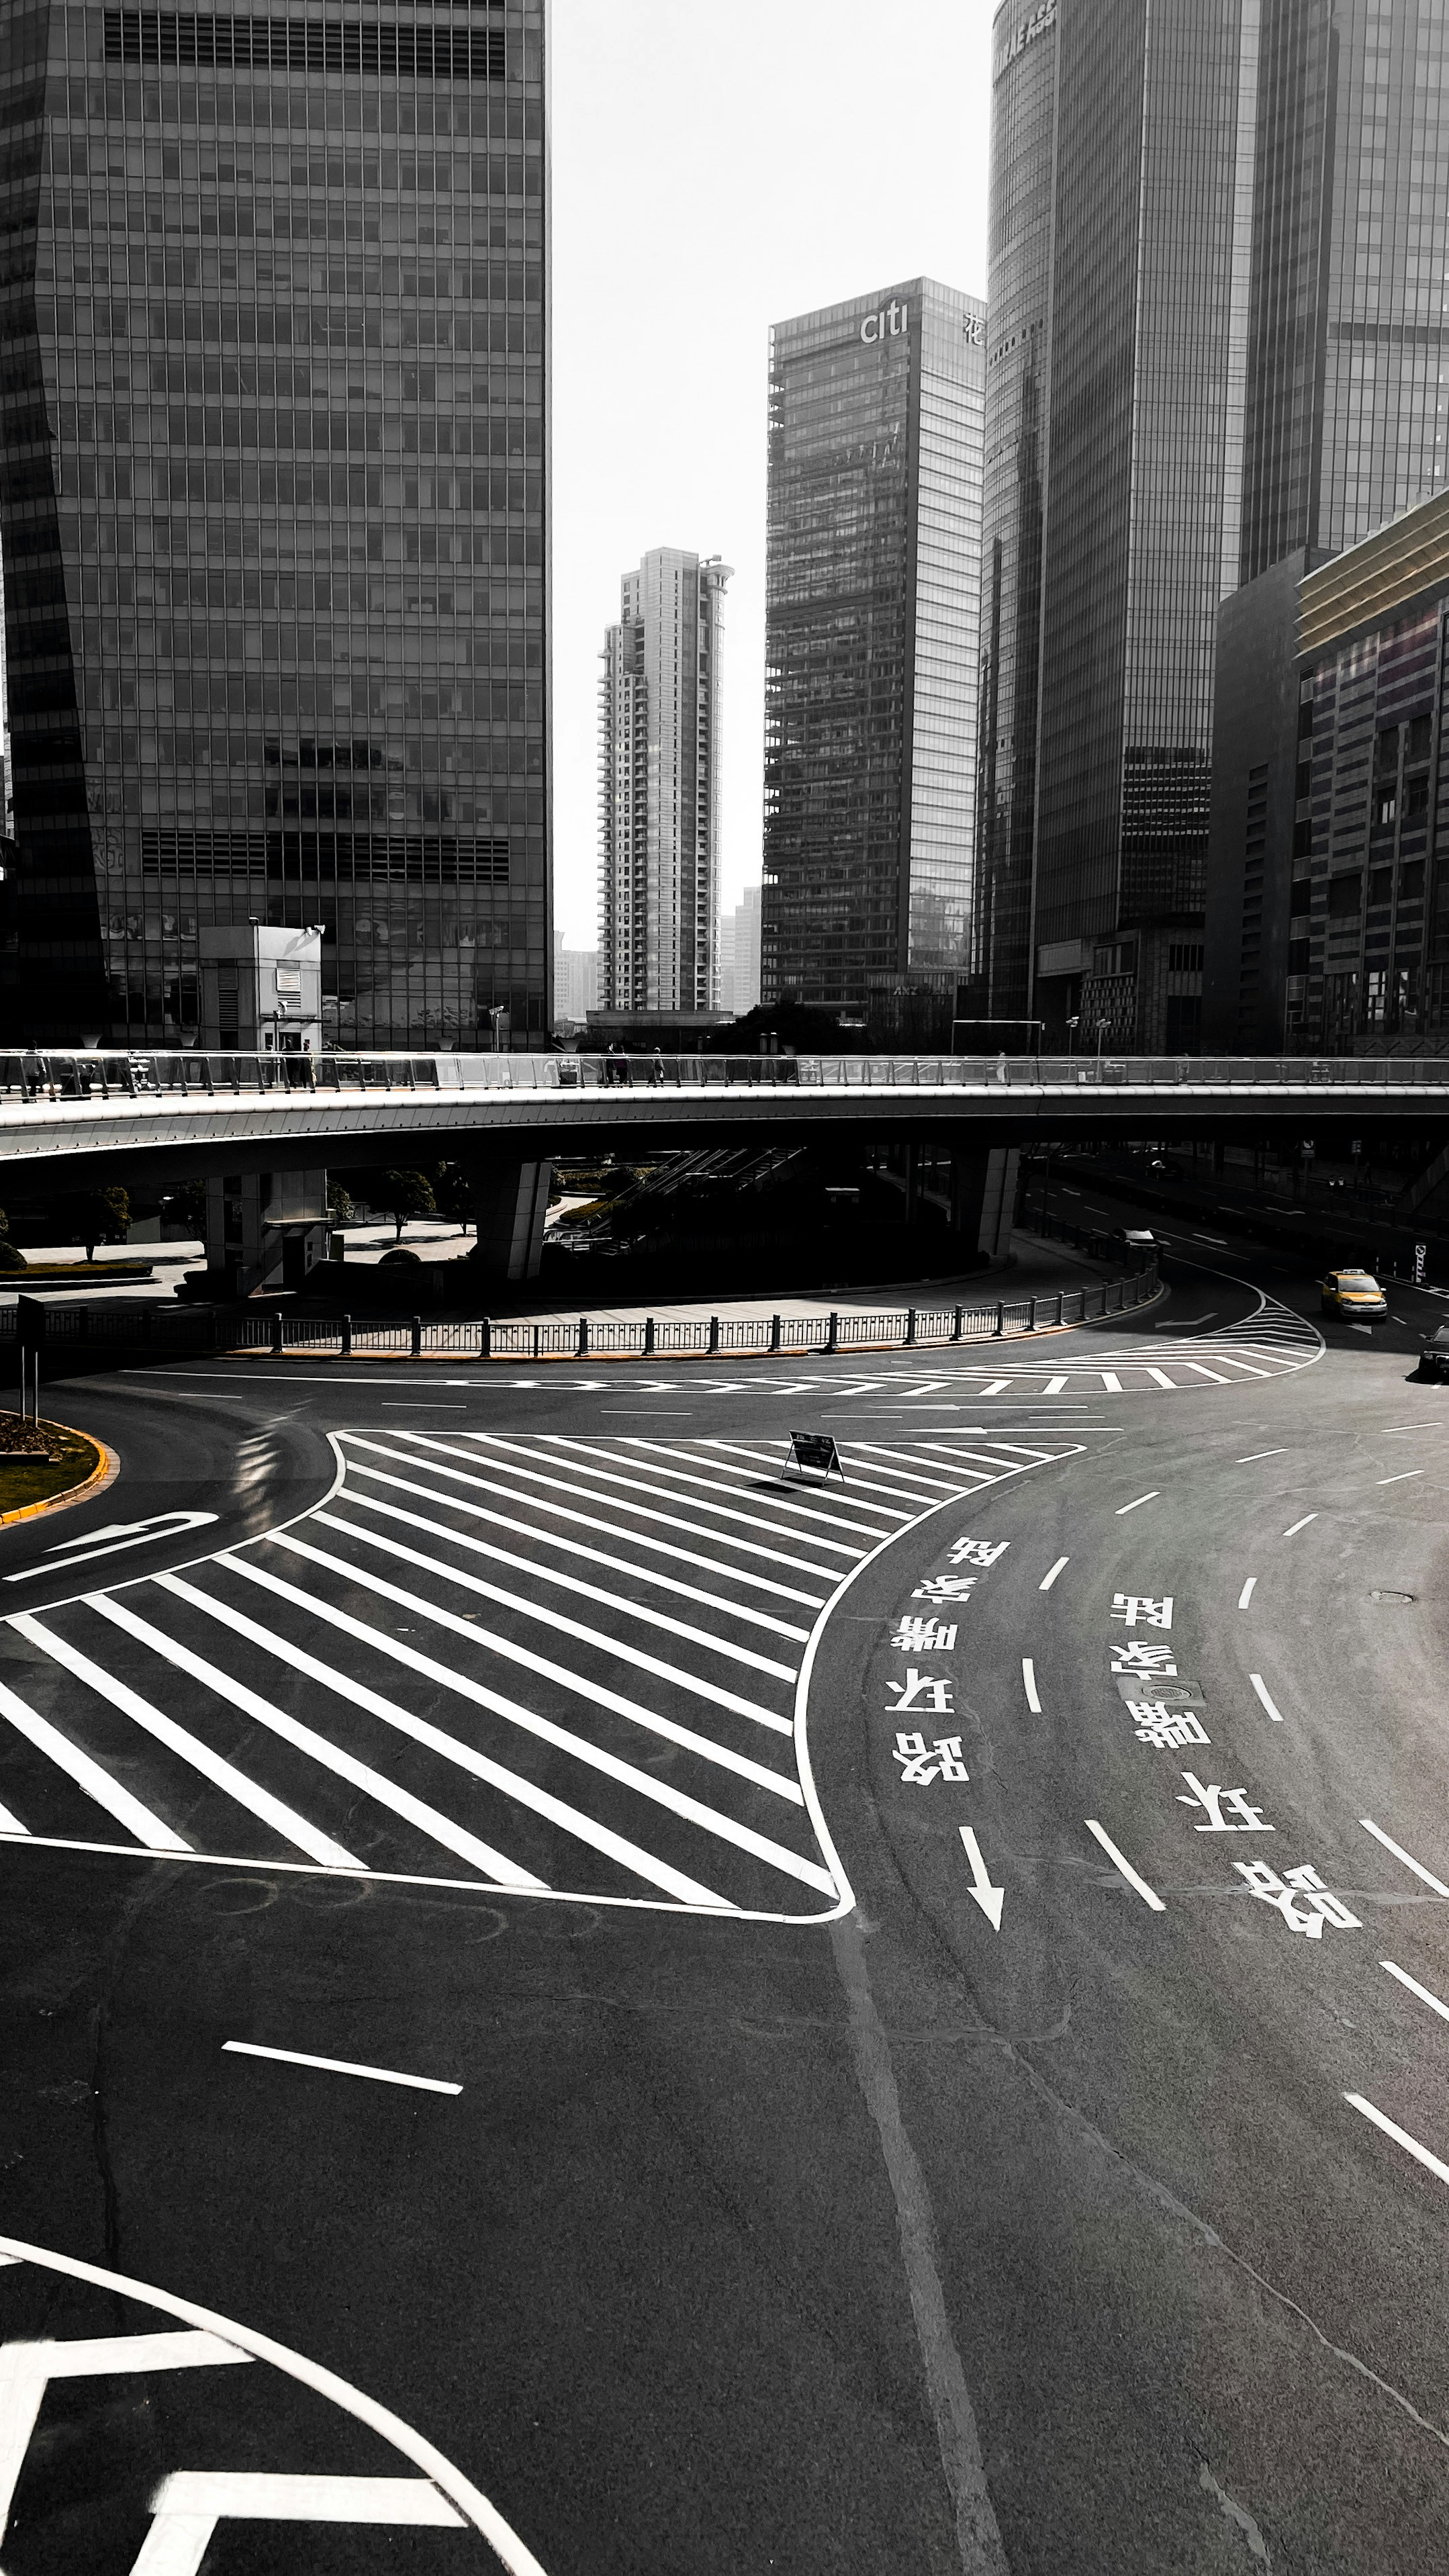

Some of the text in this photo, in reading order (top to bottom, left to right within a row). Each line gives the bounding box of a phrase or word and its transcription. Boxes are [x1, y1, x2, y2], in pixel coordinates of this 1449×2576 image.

[860, 300, 908, 343] citi
[964, 312, 985, 346] 花
[884, 1536, 1011, 1786] 陆家嘴环路
[1109, 1593, 1362, 1939] 陆家嘴环路
